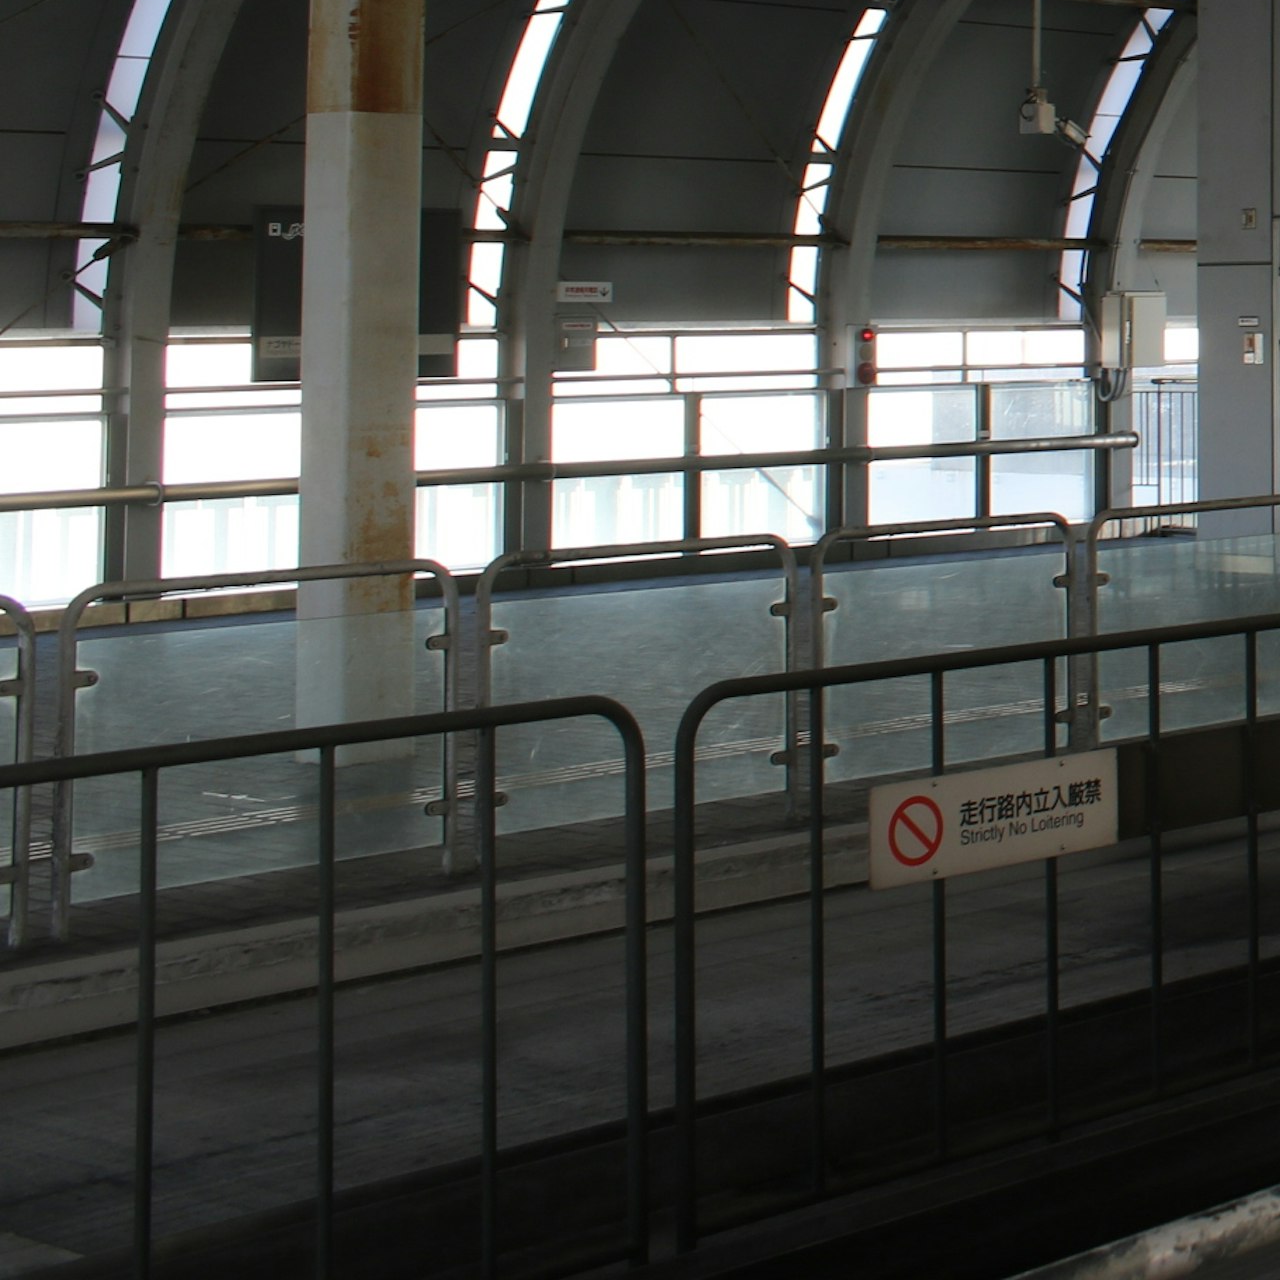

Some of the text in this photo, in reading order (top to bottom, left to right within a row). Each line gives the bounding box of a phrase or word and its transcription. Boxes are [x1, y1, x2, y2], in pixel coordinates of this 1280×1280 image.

[960, 778, 1102, 827] 走行路内立入厳禁
[960, 810, 1085, 846] Strictly No Loitering
